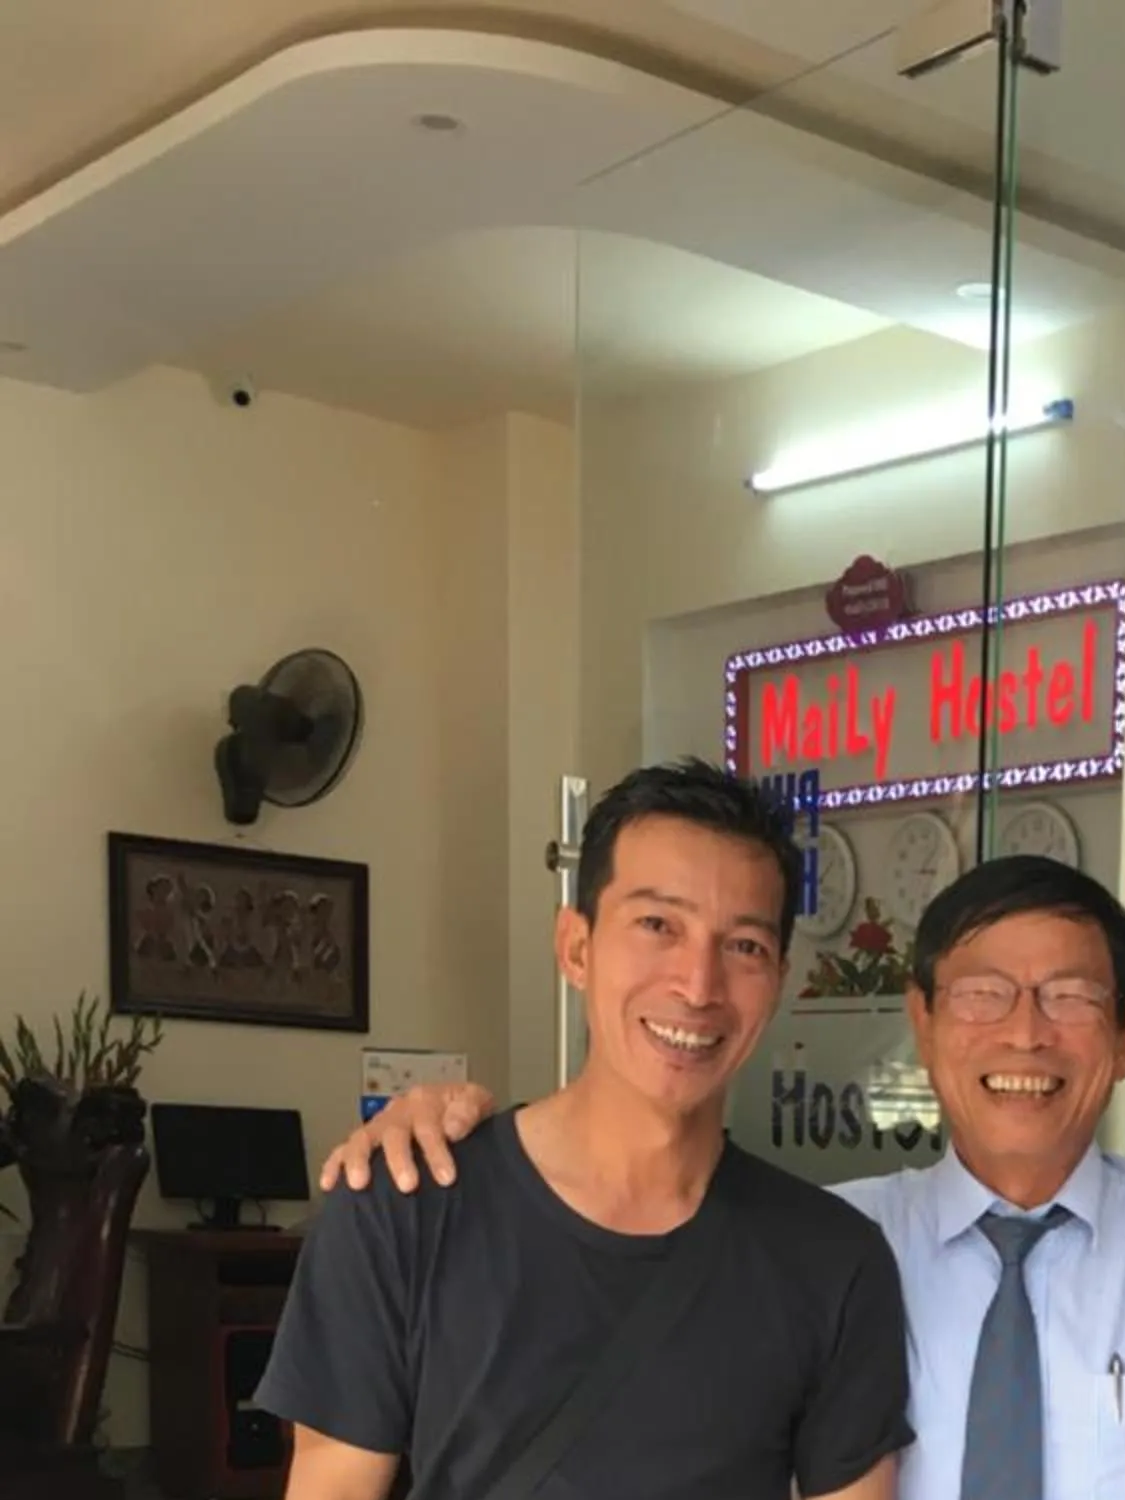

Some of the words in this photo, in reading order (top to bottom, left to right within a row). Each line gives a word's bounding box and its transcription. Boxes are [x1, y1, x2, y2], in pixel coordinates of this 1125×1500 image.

[760, 663, 897, 780] MaiLy
[929, 618, 1097, 743] Hostel
[772, 1066, 944, 1151] Hos
